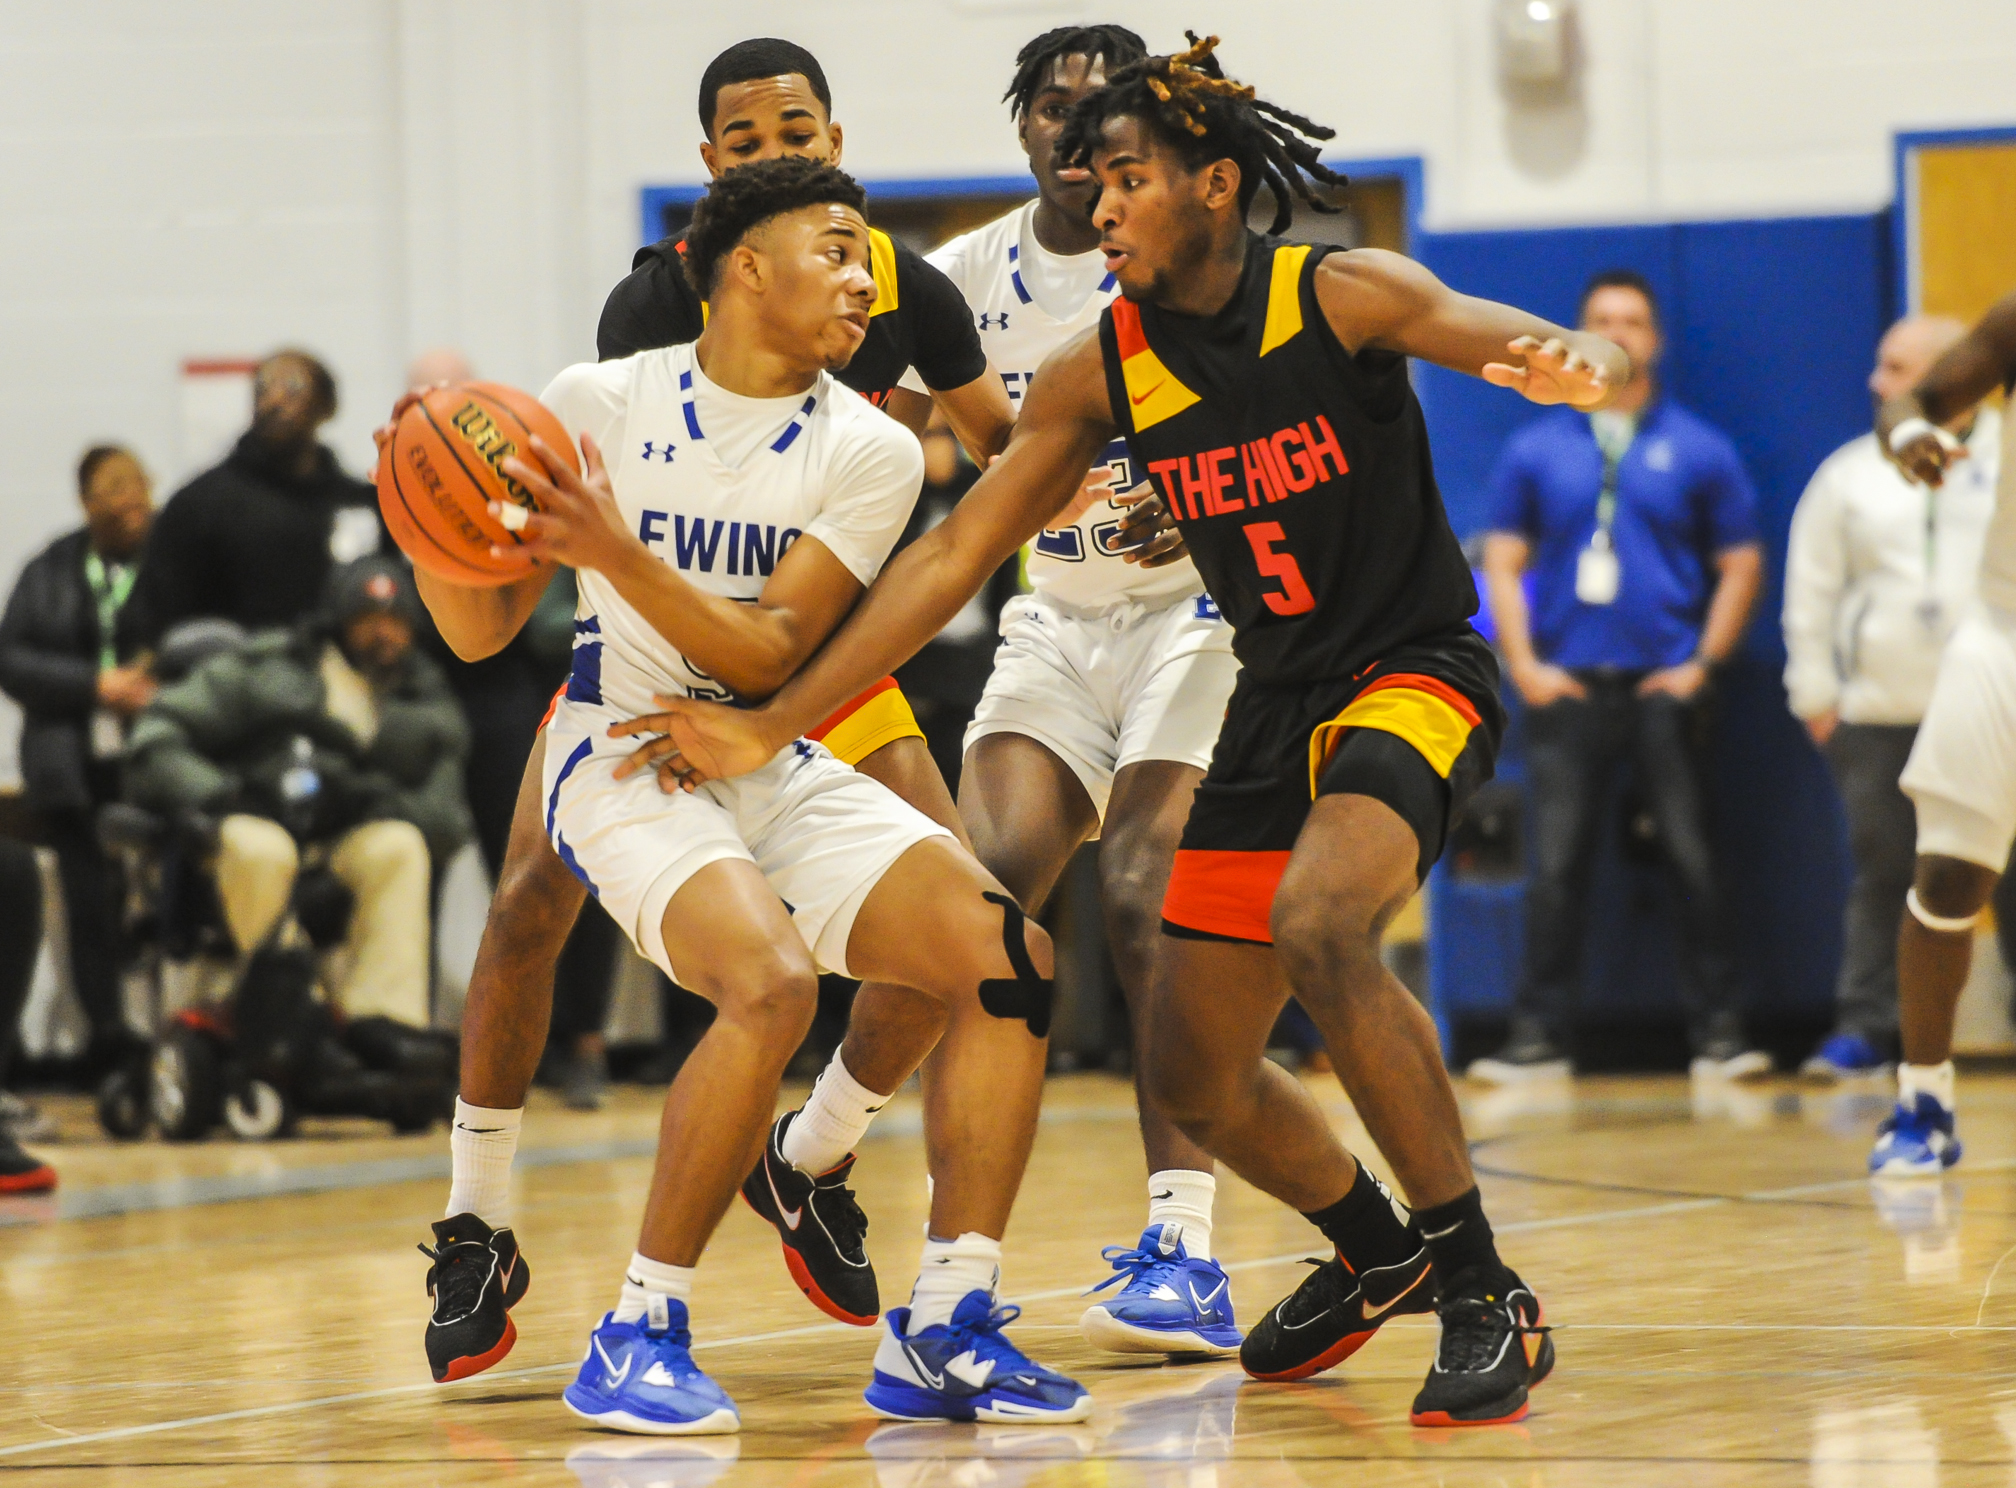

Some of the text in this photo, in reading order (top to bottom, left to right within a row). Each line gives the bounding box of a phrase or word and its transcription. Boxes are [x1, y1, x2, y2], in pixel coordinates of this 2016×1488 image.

[1147, 414, 1350, 520] THE HIGH
[1242, 521, 1316, 616] 5
